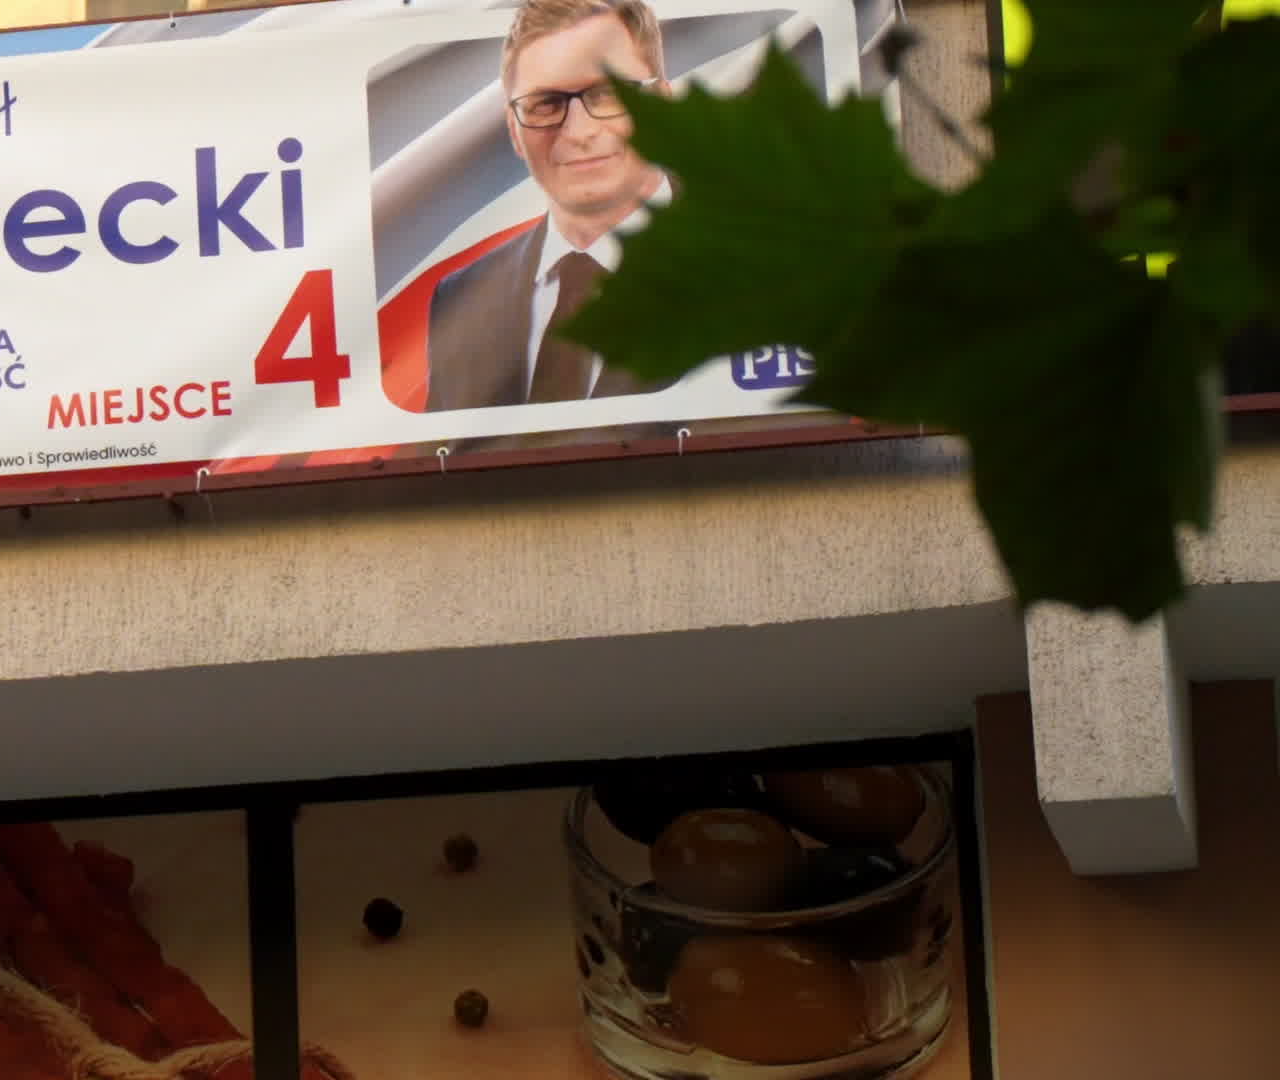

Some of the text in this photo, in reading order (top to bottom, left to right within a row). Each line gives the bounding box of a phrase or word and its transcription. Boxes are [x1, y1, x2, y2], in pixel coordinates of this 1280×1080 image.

[47, 268, 352, 429] MIEJSCE 4
[741, 343, 817, 381] PiS
[36, 441, 158, 468] Sprawiedliwość
